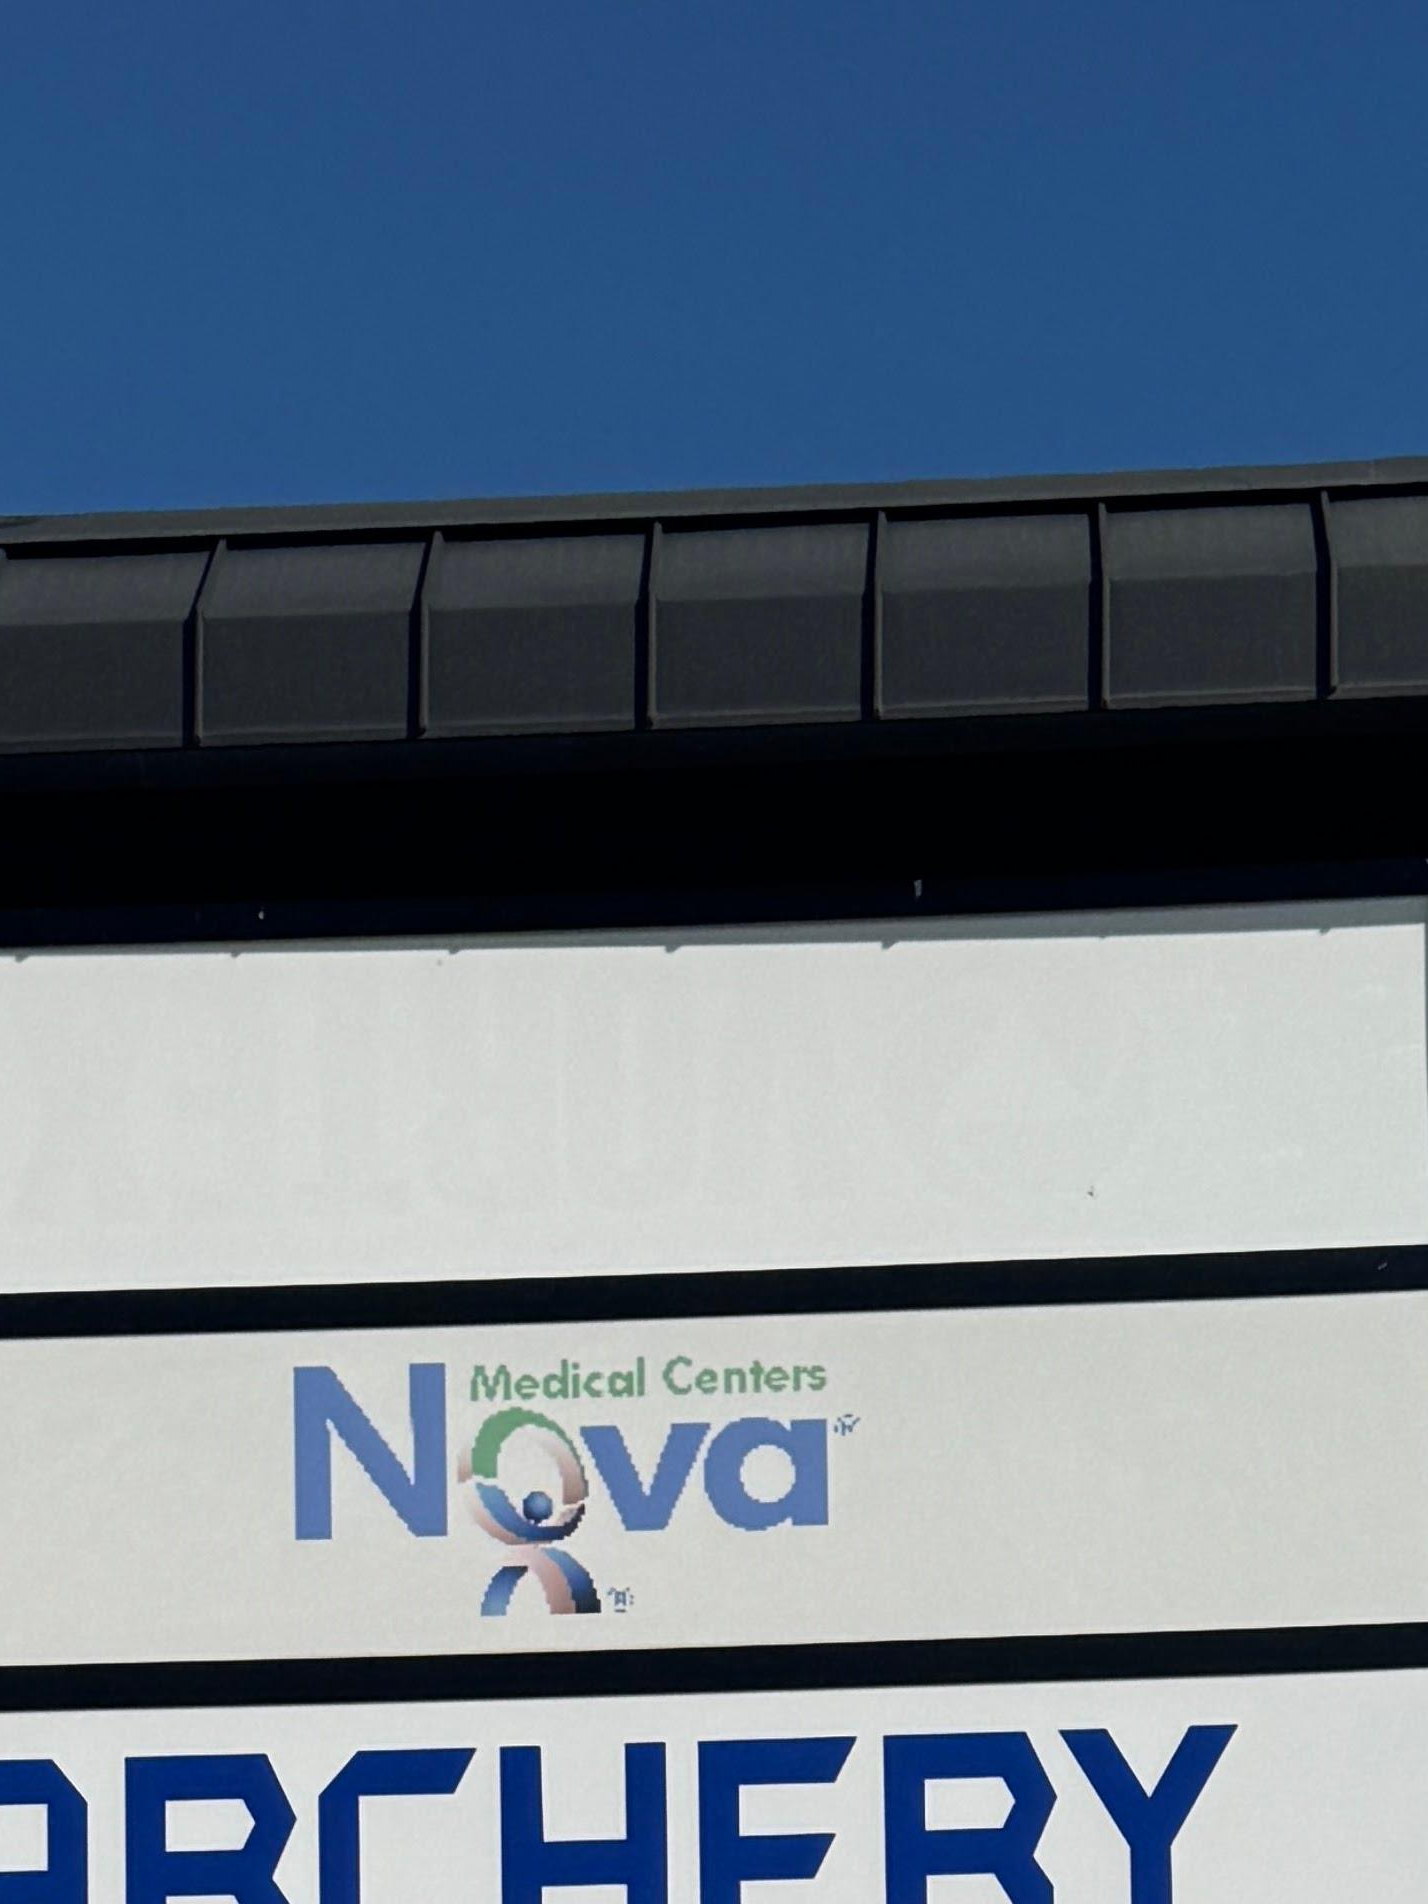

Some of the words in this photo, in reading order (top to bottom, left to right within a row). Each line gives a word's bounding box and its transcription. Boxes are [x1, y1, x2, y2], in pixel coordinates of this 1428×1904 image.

[470, 1356, 646, 1401] Medical
[662, 1355, 828, 1395] Centers
[293, 1362, 830, 1544] Nova
